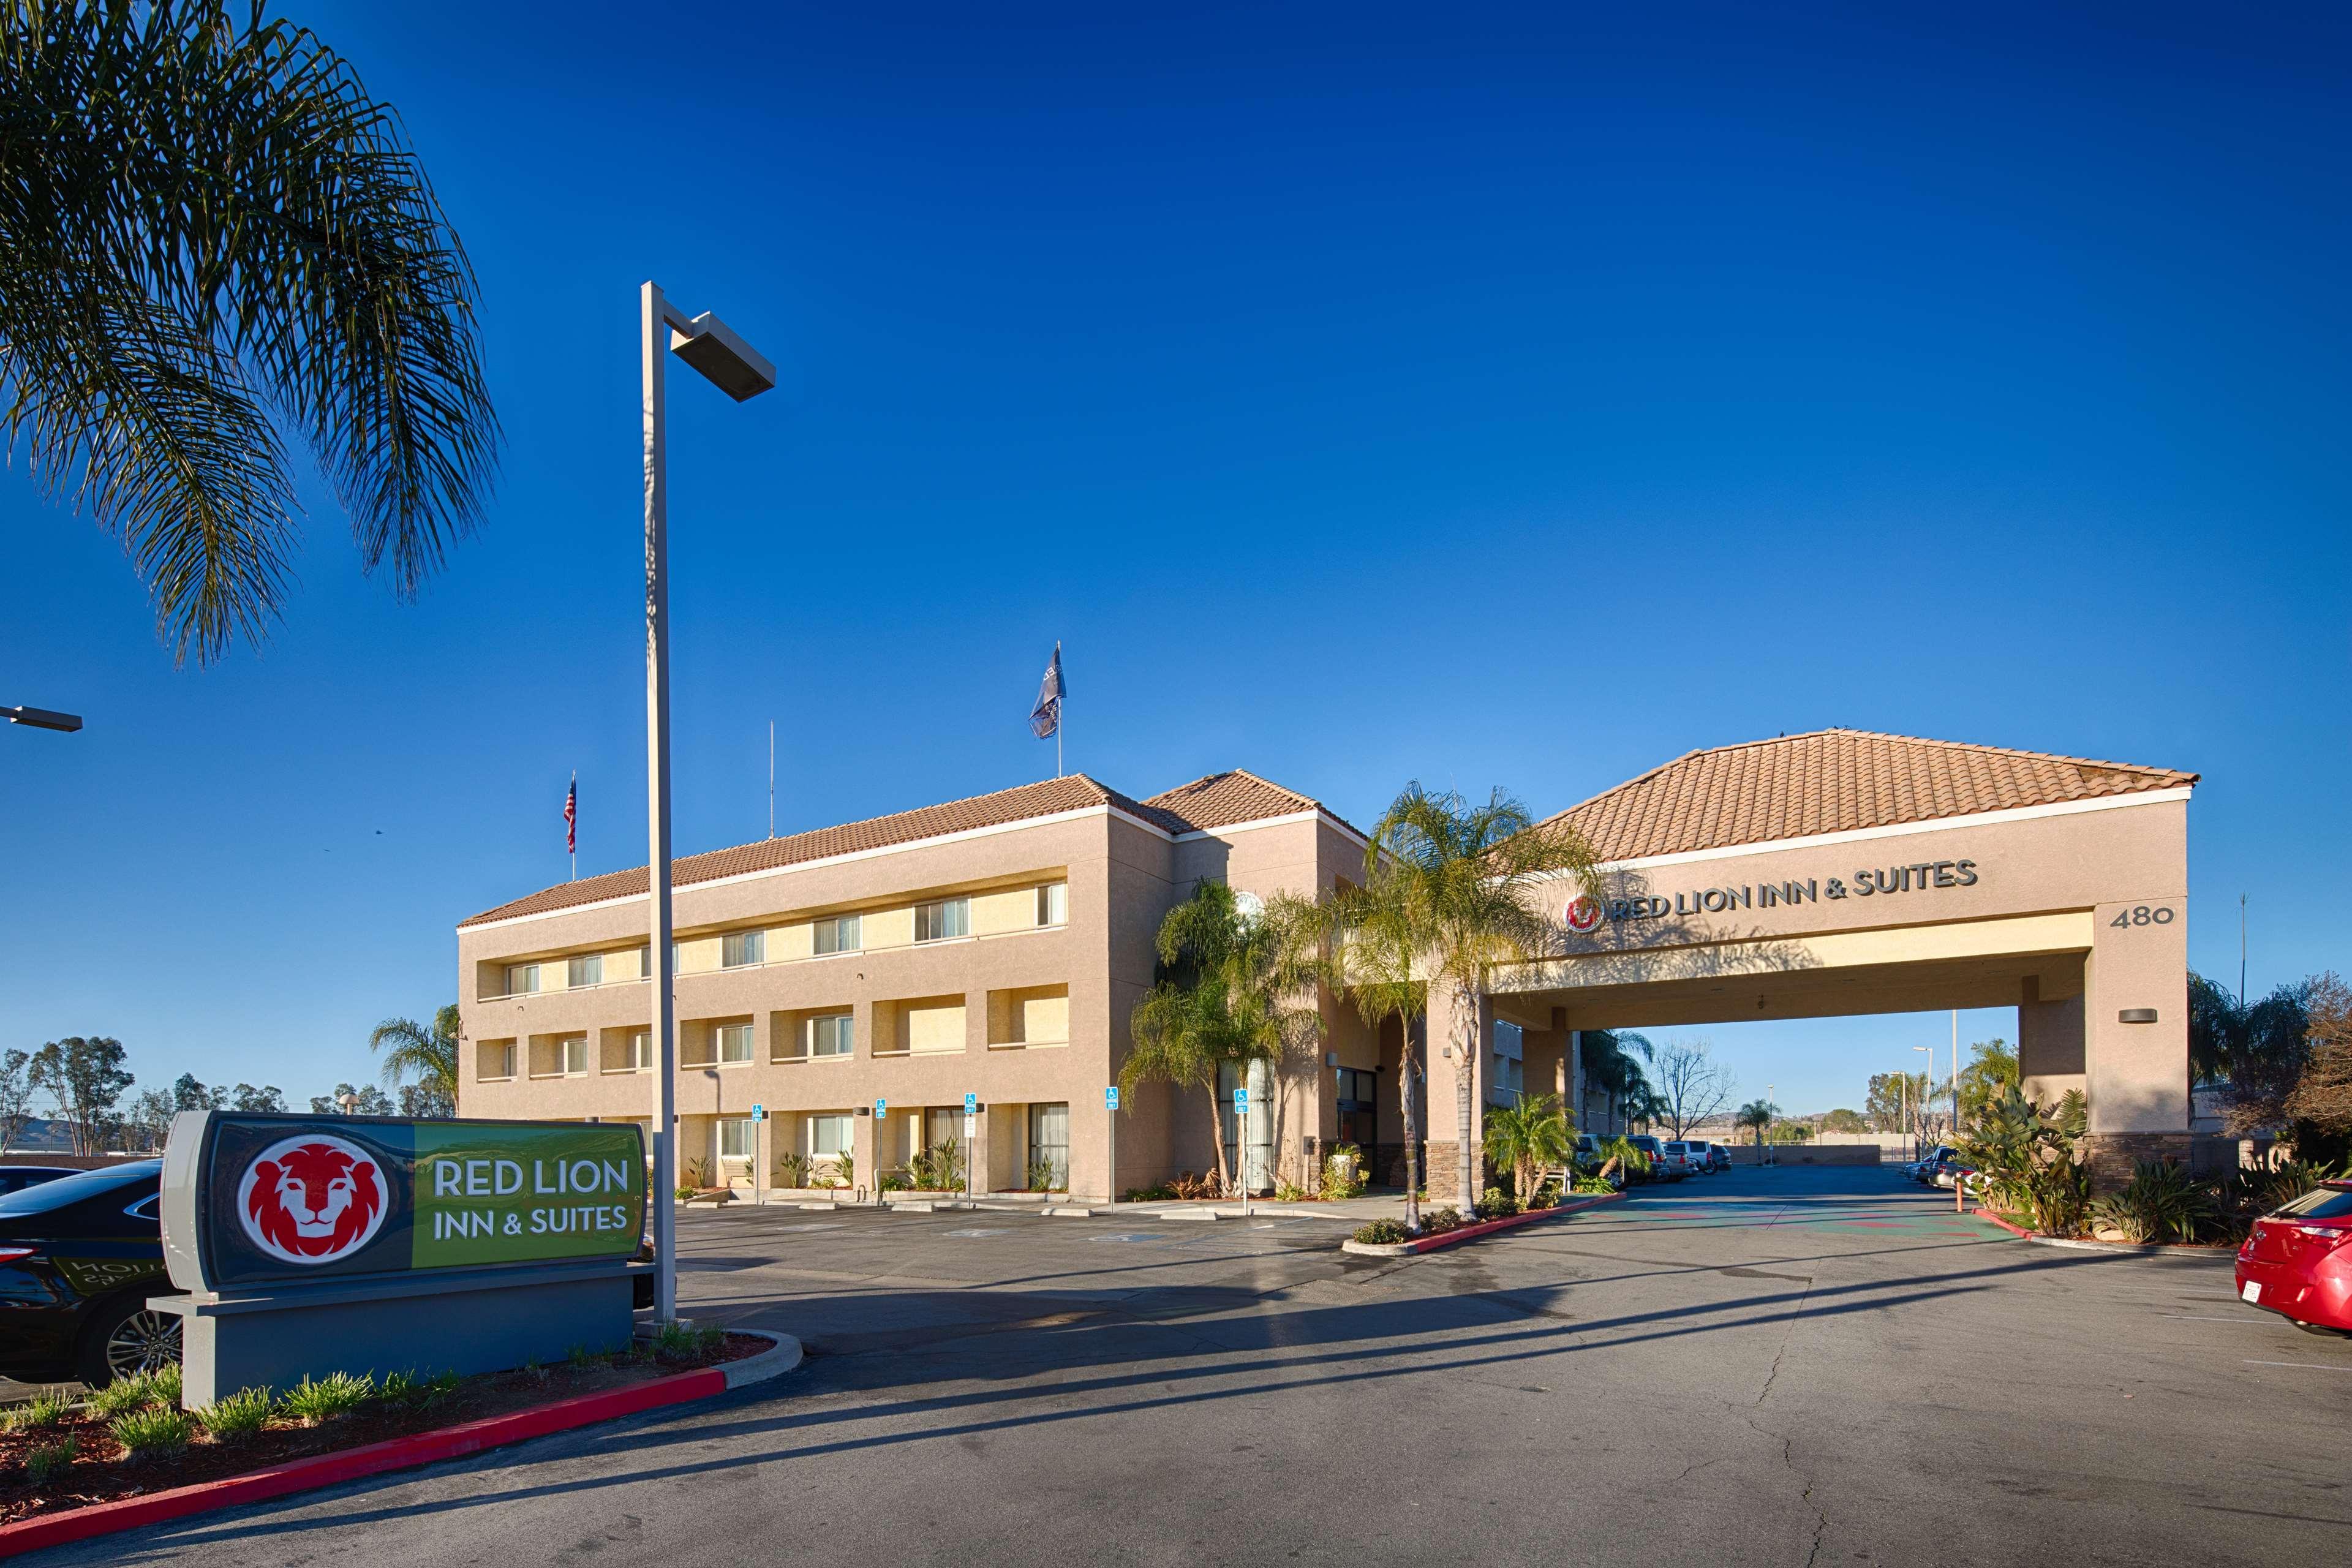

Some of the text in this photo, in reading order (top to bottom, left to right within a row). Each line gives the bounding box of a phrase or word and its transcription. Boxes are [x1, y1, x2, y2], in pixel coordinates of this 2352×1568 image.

[1611, 859, 1978, 921] RED LION INN & SUITES
[2110, 906, 2174, 929] 480
[435, 1158, 628, 1197] RED LION
[434, 1205, 628, 1240] INN & SUITES
